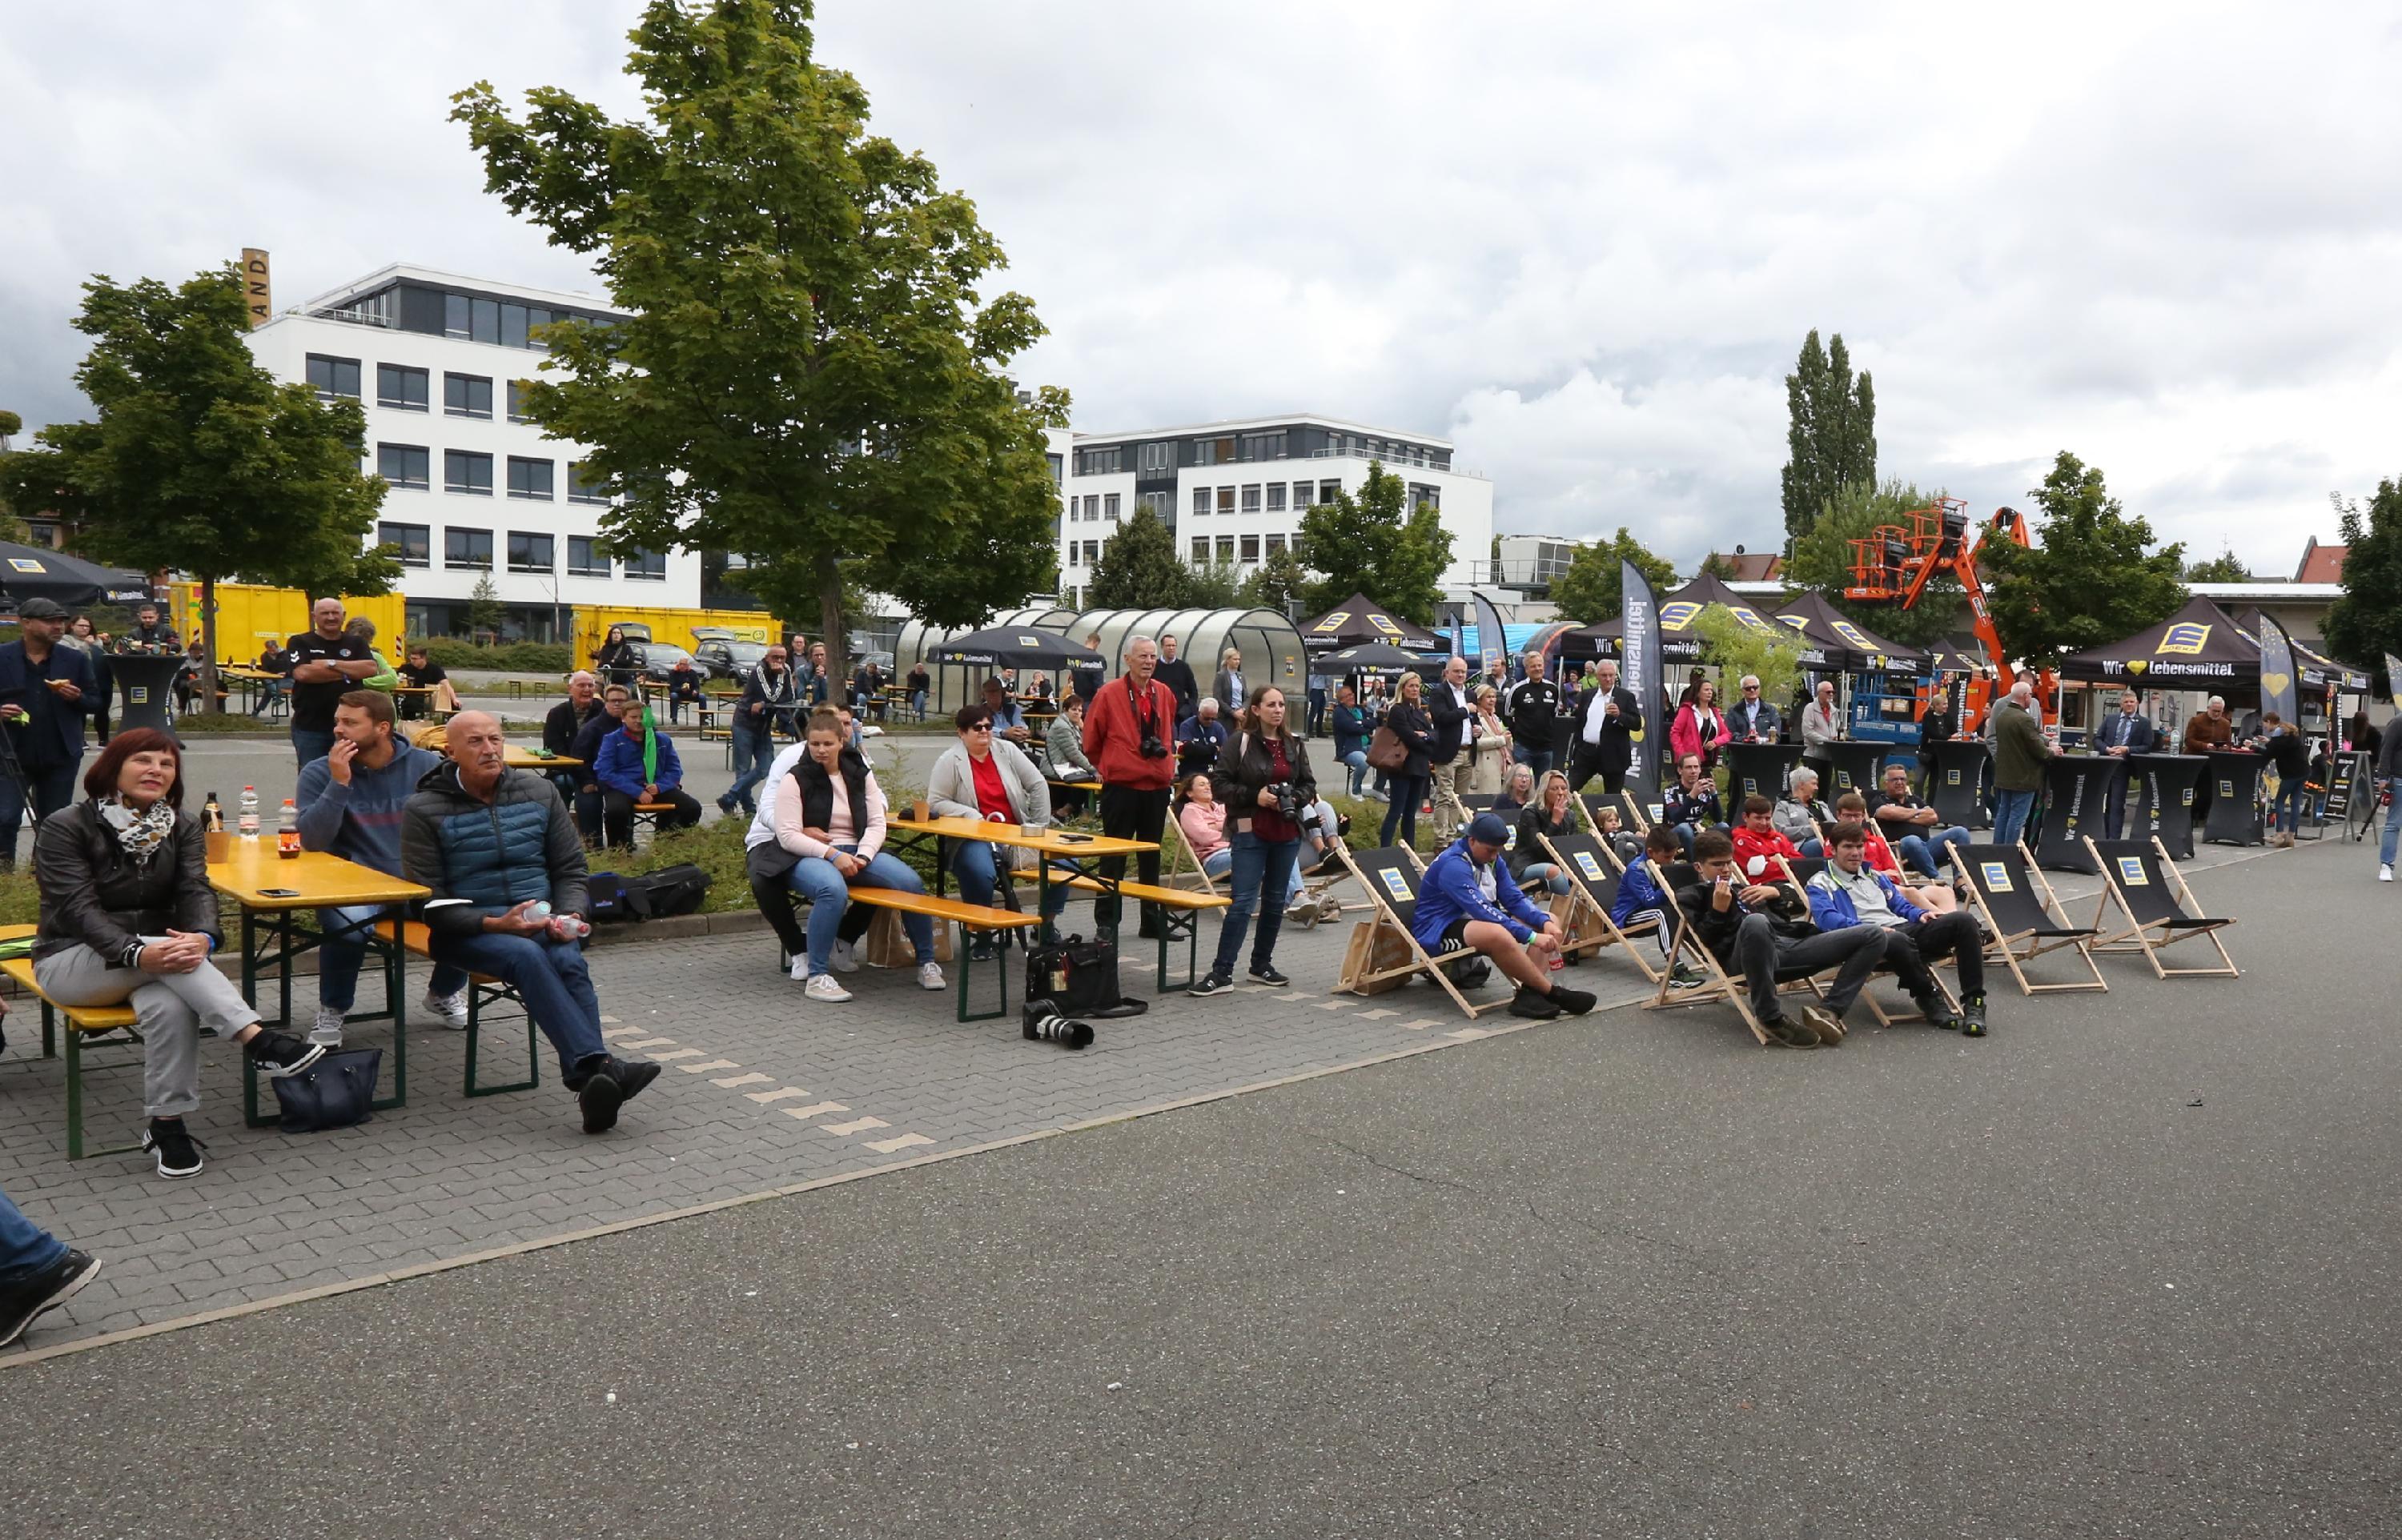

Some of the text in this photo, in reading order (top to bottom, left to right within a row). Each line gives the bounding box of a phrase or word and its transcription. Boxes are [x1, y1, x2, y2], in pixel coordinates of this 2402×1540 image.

[1595, 638, 1613, 653] Wir
[2103, 660, 2235, 676] Wir Lebensmittel.
[1958, 677, 1967, 737] ebensmittel.
[2150, 819, 2160, 831] Wir
[2064, 828, 2076, 840] Wir
